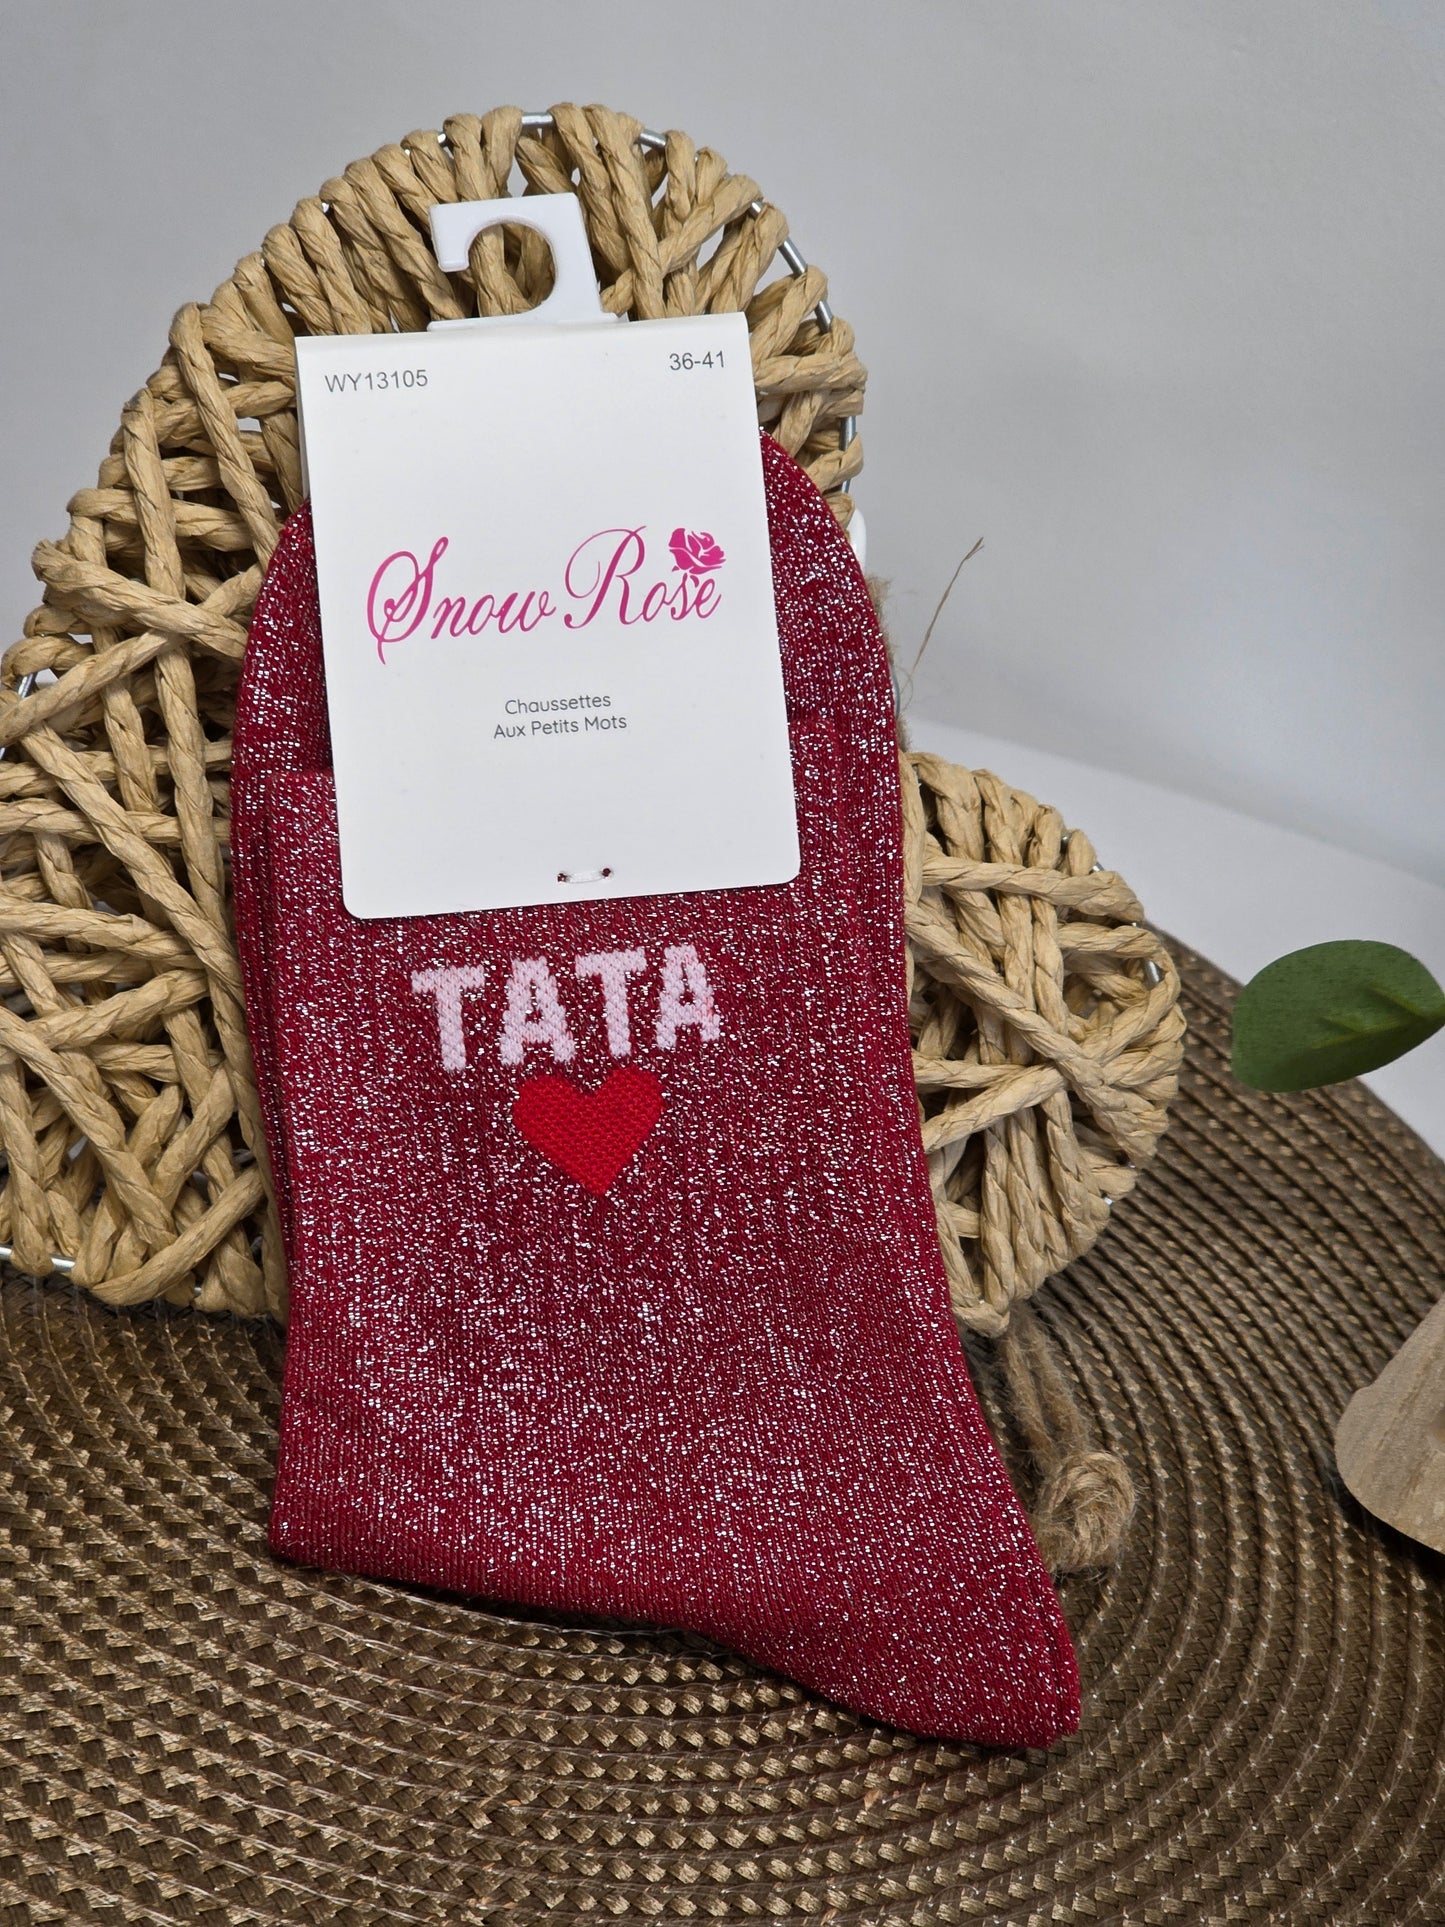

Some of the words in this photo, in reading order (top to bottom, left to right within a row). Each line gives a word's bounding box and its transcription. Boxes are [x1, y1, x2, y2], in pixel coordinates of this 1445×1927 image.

[669, 351, 726, 371] 36-41
[324, 370, 428, 393] WY13105
[367, 536, 556, 665] Snow
[564, 525, 722, 630] Rose
[504, 693, 612, 715] Chaussettes
[493, 723, 526, 740] Aux
[531, 717, 579, 737] Petits
[584, 714, 627, 734] Mots
[411, 945, 721, 1072] TATA
